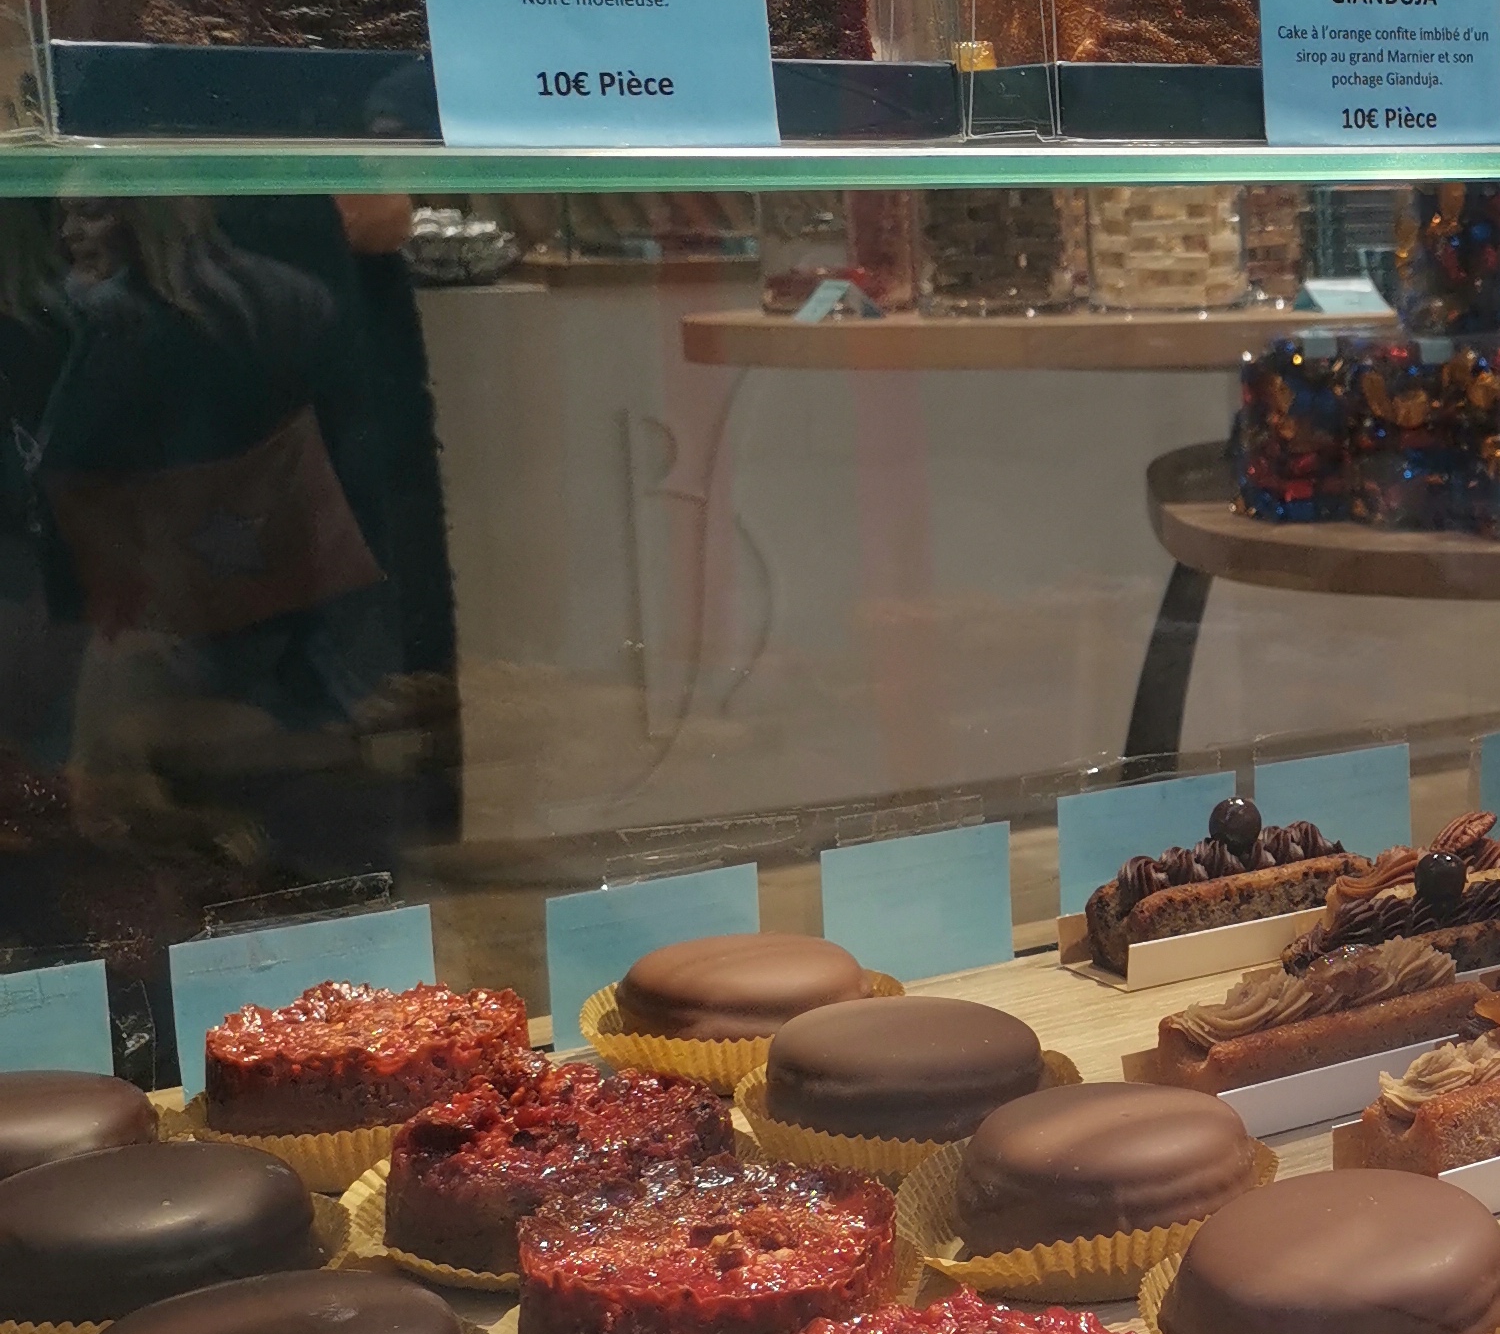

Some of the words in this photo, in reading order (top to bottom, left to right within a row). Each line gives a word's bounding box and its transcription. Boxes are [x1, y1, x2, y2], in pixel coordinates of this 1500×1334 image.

[1277, 24, 1308, 40] Cake
[1310, 24, 1319, 40] à
[1320, 24, 1372, 44] l'orange
[1374, 25, 1417, 41] confite
[1418, 26, 1460, 41] imbibé
[1295, 49, 1328, 66] sirop
[1329, 52, 1346, 63] au
[1348, 48, 1384, 66] grand
[1386, 49, 1435, 64] Marnier
[1437, 52, 1451, 64] et
[1452, 53, 1474, 64] son
[536, 70, 591, 97] 10€
[599, 70, 674, 97] Pièce
[1330, 71, 1384, 89] pochage
[1385, 71, 1443, 89] Gianduja.
[1341, 106, 1379, 129] 10€
[1384, 105, 1437, 129] Pièce
